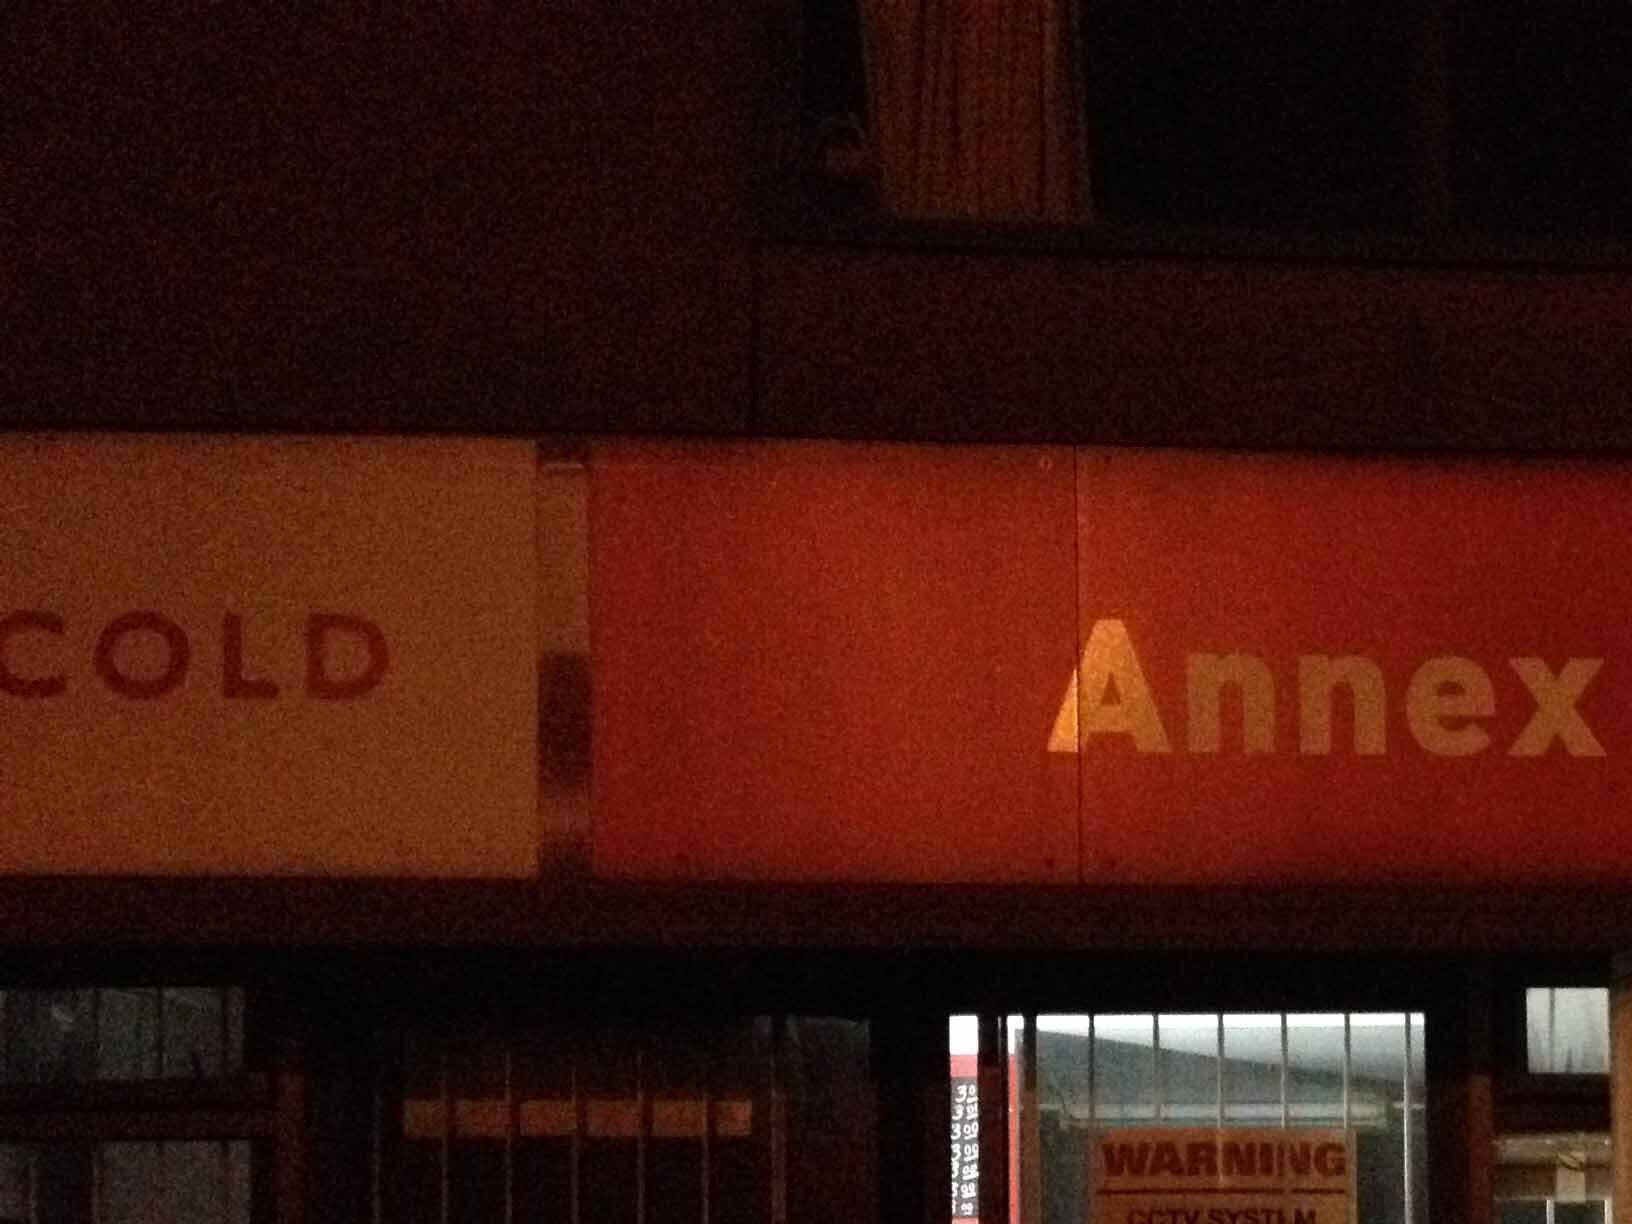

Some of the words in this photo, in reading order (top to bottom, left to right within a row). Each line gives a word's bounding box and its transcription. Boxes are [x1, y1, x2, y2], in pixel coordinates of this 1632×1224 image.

[0, 609, 390, 699] COLD
[1047, 618, 1607, 757] Annex
[1101, 1141, 1345, 1177] WARNING
